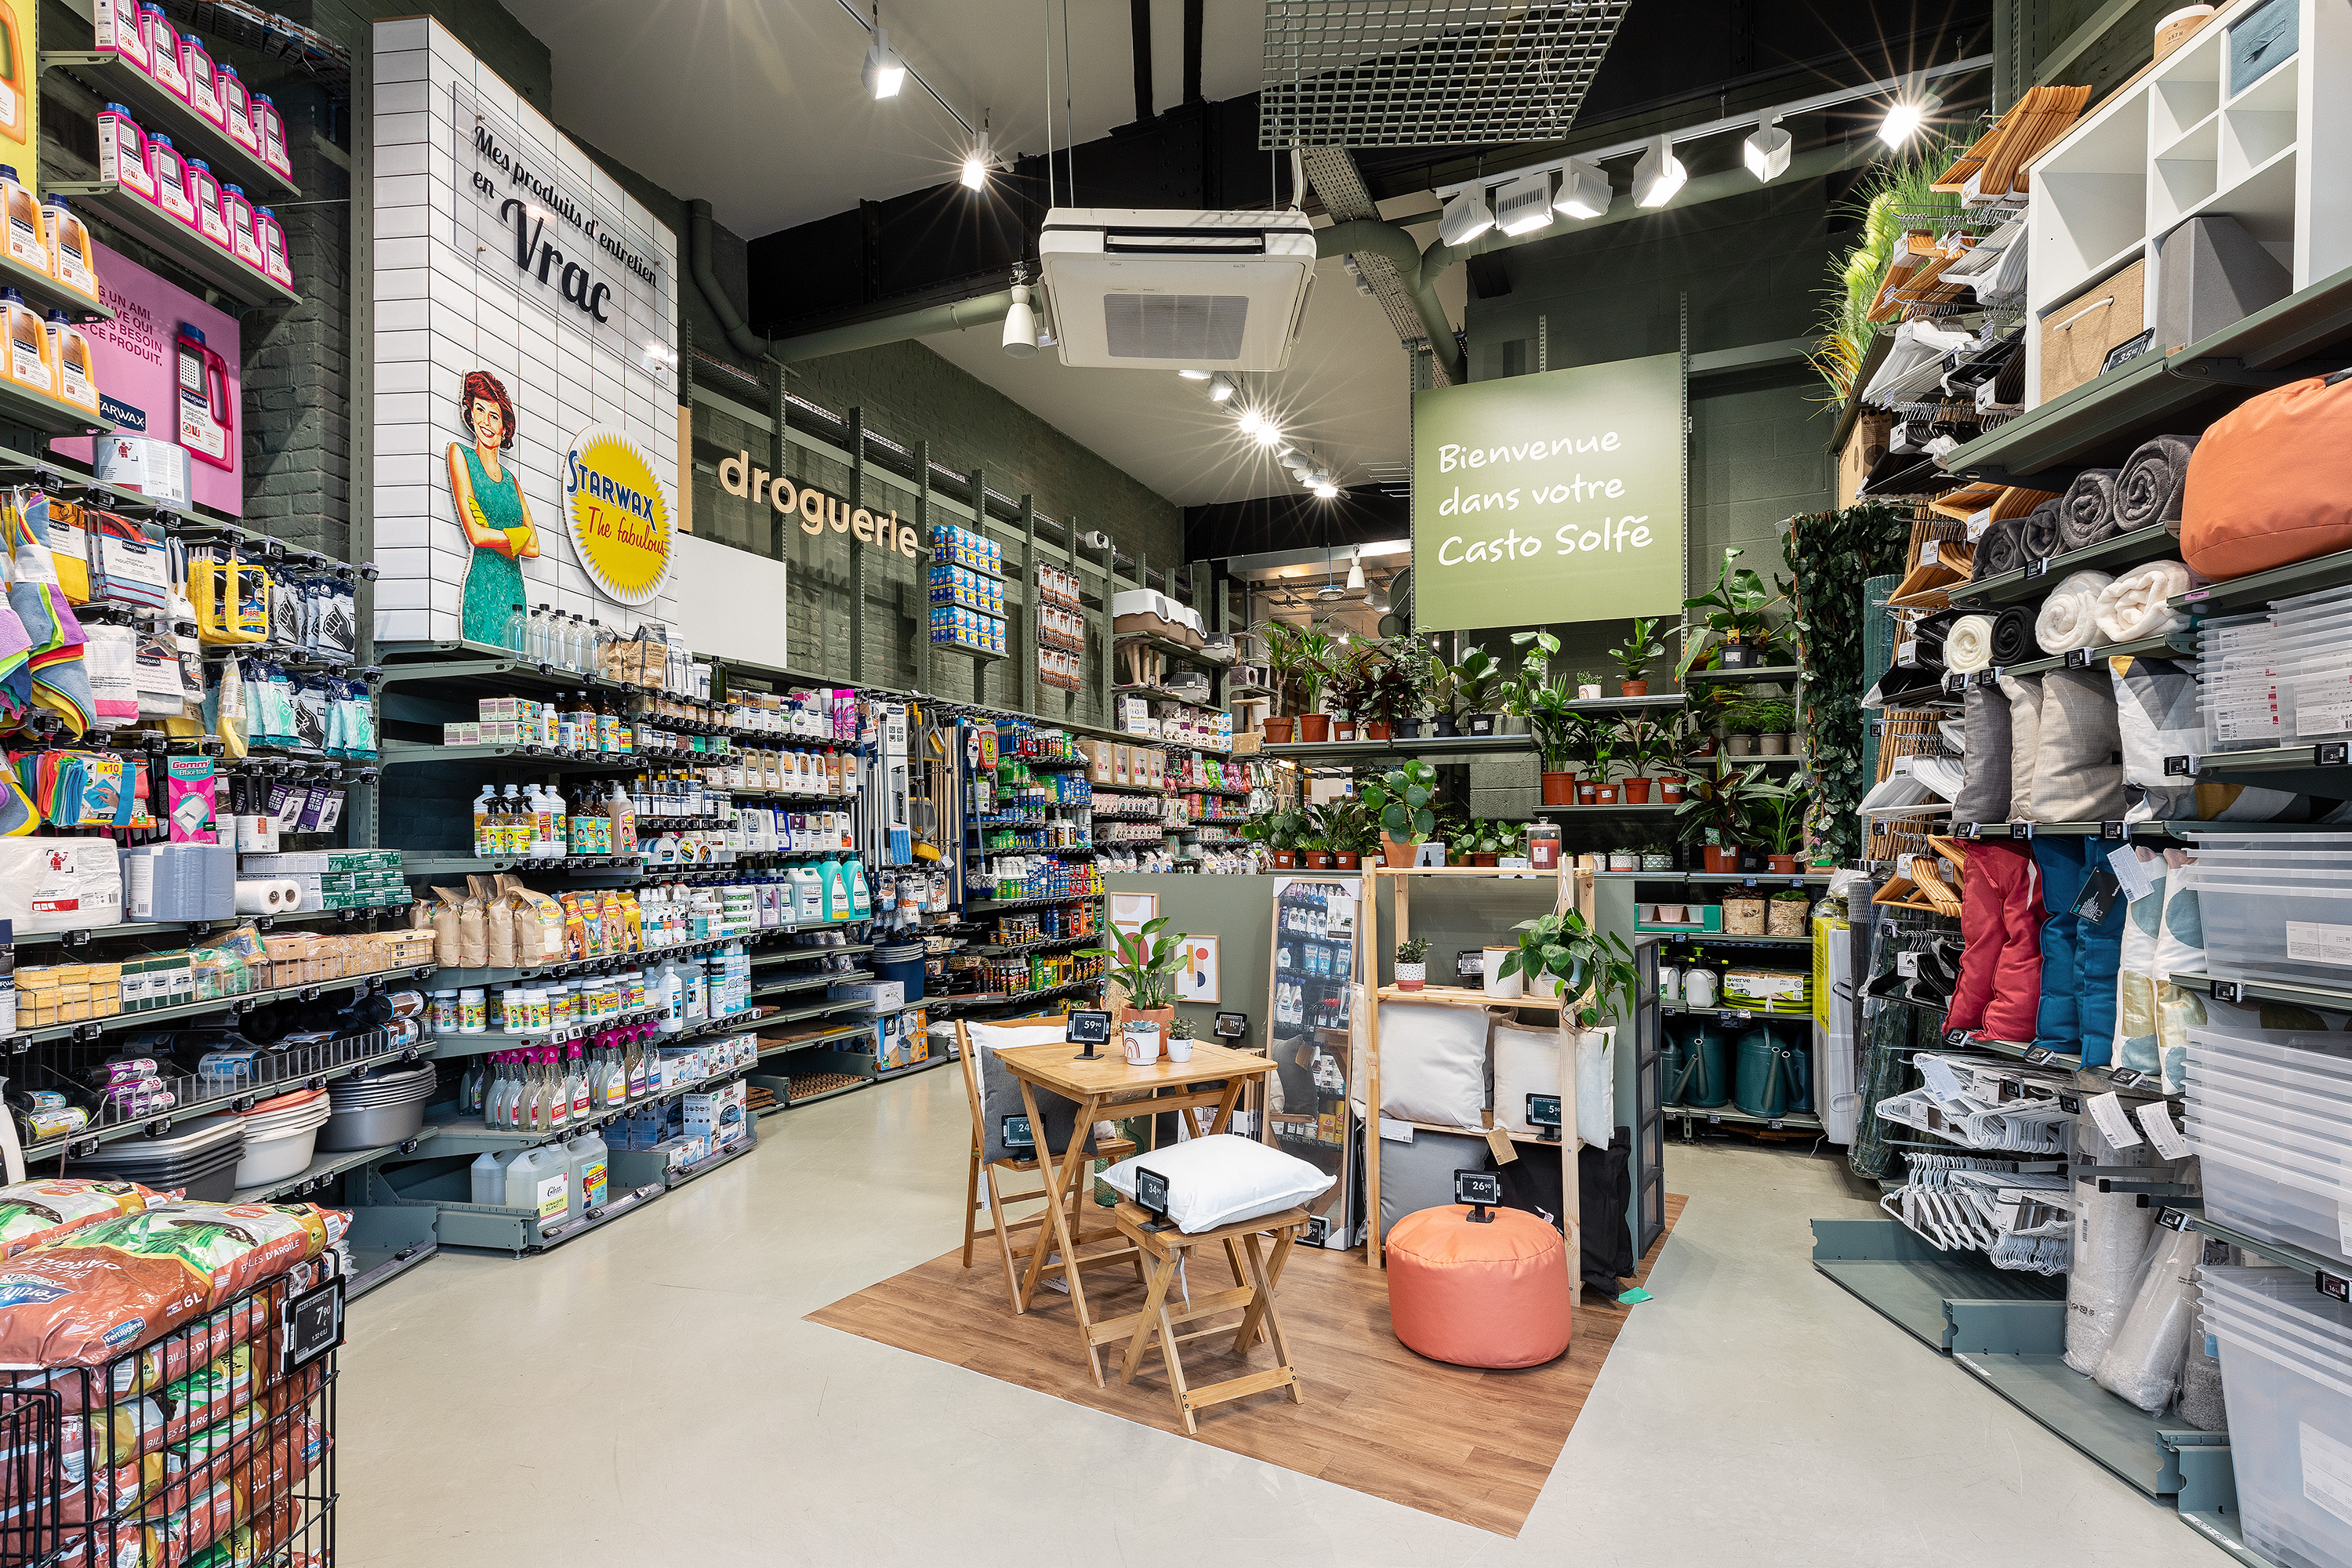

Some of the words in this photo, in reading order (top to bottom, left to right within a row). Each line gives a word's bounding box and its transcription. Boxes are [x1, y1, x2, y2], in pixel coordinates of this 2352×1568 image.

[474, 125, 510, 172] Mes
[513, 162, 581, 228] produits
[474, 171, 495, 198] en
[501, 198, 612, 324] Vrac
[109, 292, 126, 308] UN
[129, 301, 151, 321] AMI
[119, 323, 162, 354] BESOIN
[132, 317, 153, 336] QUI
[89, 325, 106, 340] CE
[110, 335, 162, 367] PRODUIT.
[182, 391, 208, 408] STARWAX
[100, 400, 145, 428] ARWAX
[1439, 431, 1621, 473] Bienvenue
[567, 450, 658, 532] STARWAX
[717, 449, 918, 558] droguerie
[1439, 486, 1521, 517] dans
[1532, 473, 1625, 506] votre
[589, 506, 612, 539] The
[617, 517, 665, 557] fabulous
[1438, 528, 1542, 566] Casto
[1555, 515, 1653, 555] Solfé
[122, 541, 147, 554] STARWAX
[115, 558, 139, 568] INDUCTION
[172, 760, 210, 770] Gomm'
[546, 1198, 564, 1207] VINAIGRE
[266, 1239, 299, 1261] D'ARGILE
[184, 1292, 202, 1308] 6L
[297, 1303, 308, 1313] BILLES
[309, 1296, 324, 1307] D'ARGILE
[167, 1344, 196, 1365] BILLS
[180, 1406, 223, 1433] DARGLE
[191, 1452, 230, 1480] D'AGILE
